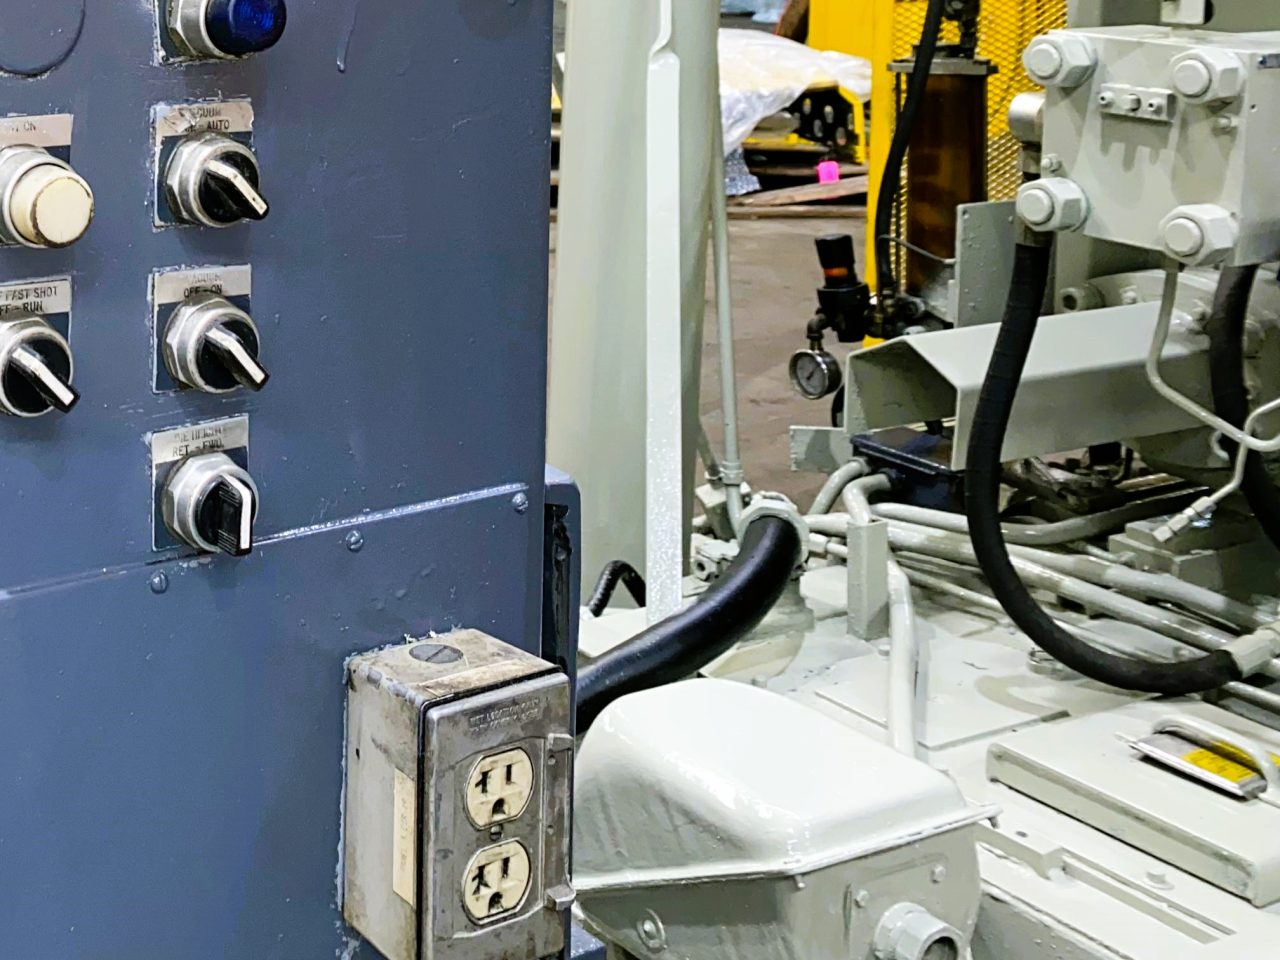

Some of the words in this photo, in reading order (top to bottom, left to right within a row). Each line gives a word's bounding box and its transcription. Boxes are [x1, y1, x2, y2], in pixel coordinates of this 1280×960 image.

[207, 119, 230, 131] AUTO
[6, 289, 30, 301] FAST
[33, 286, 58, 298] SHOT
[210, 284, 223, 295] ON
[22, 301, 44, 313] RUN
